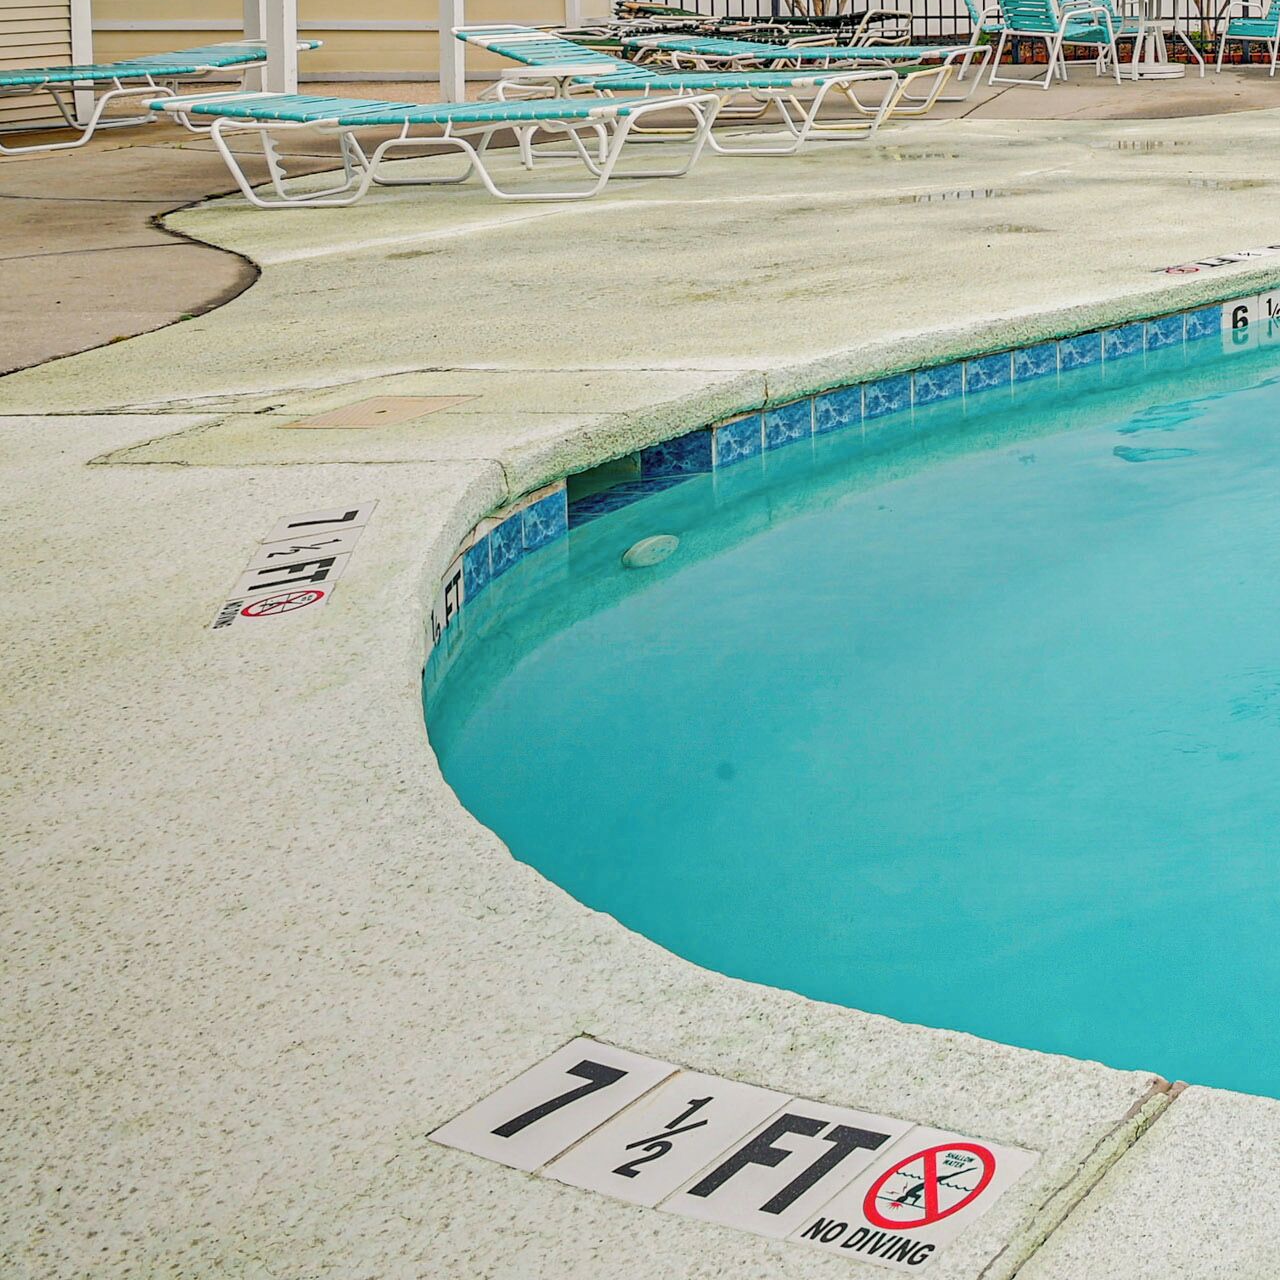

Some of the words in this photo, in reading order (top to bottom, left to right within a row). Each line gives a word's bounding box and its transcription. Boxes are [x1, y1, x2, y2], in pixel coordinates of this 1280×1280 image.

[1232, 305, 1249, 329] 6
[287, 509, 359, 529] 7
[247, 556, 336, 591] FT
[445, 569, 461, 629] FT
[490, 1059, 628, 1139] 7
[686, 1112, 892, 1216] FT
[801, 1217, 848, 1243] NO
[840, 1227, 935, 1265] DIVING
